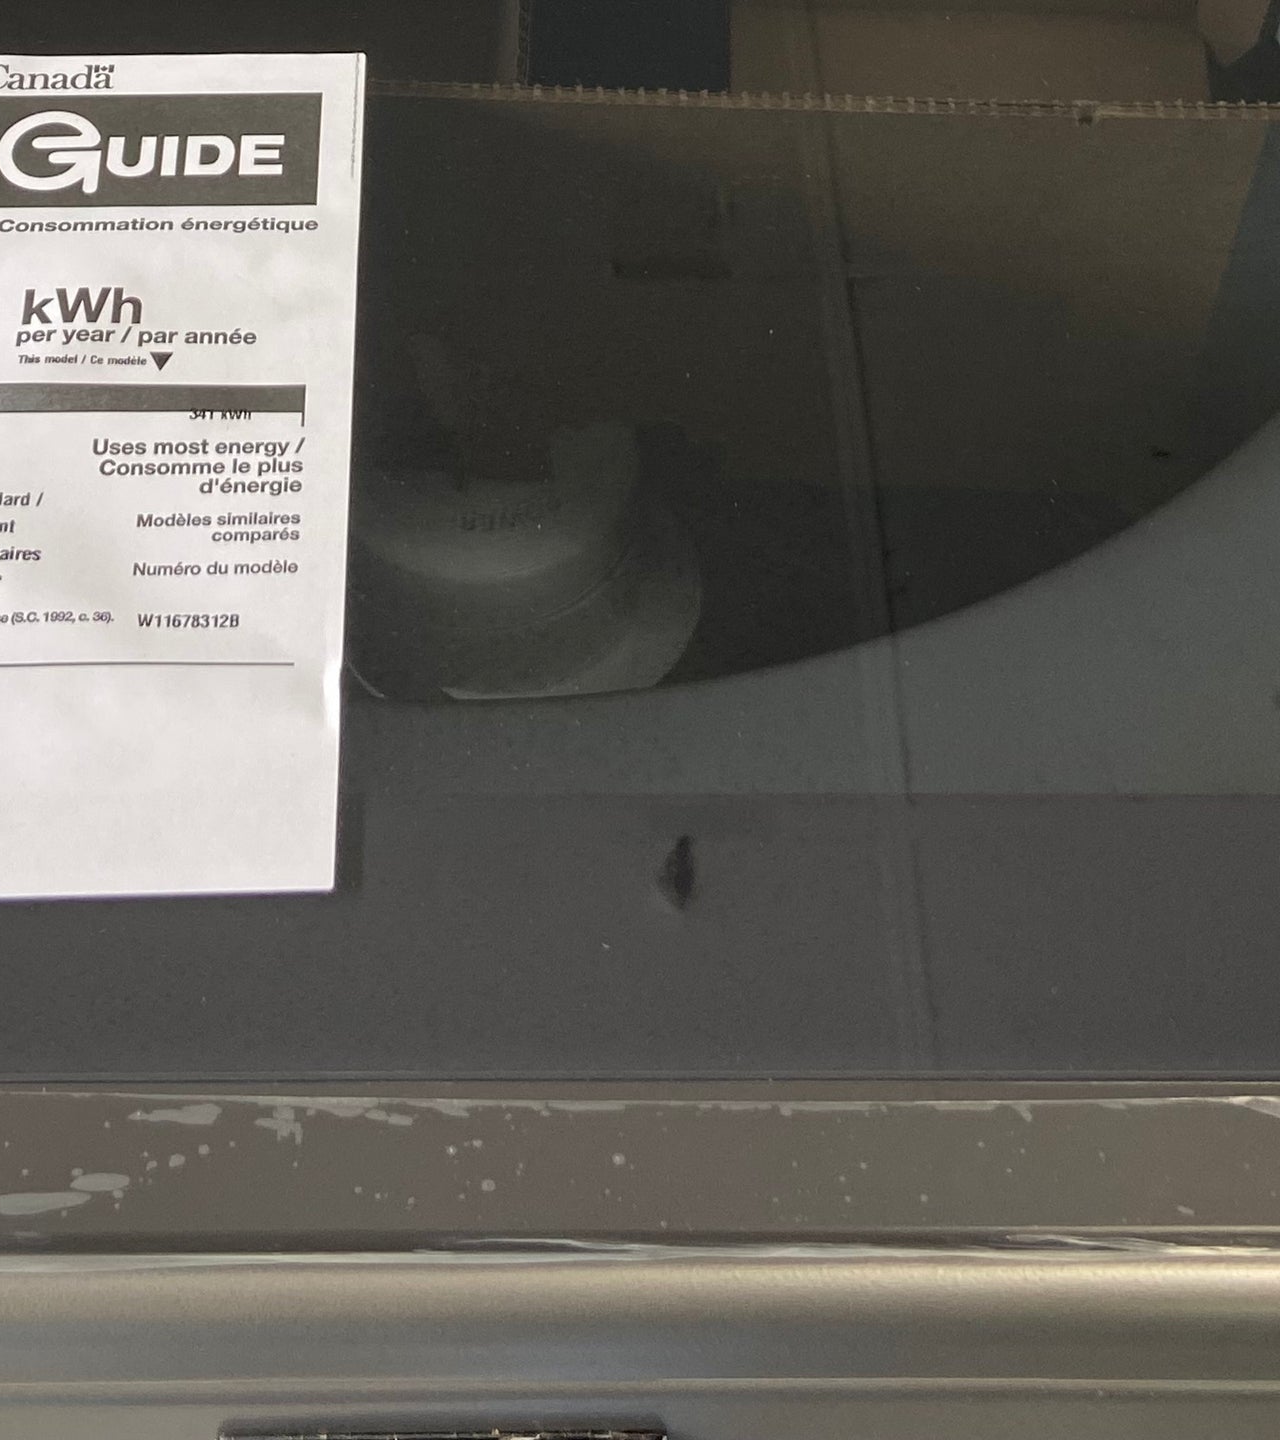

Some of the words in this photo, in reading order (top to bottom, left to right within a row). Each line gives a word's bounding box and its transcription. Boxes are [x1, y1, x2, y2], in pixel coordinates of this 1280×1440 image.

[181, 217, 318, 233] énergétique
[20, 286, 144, 325] kWh
[16, 329, 57, 347] per
[62, 329, 116, 345] year
[138, 331, 178, 347] par
[184, 328, 257, 345] année
[93, 439, 147, 455] Uses
[154, 439, 209, 455] most
[215, 442, 290, 457] energy
[138, 614, 239, 628] W11678312B
